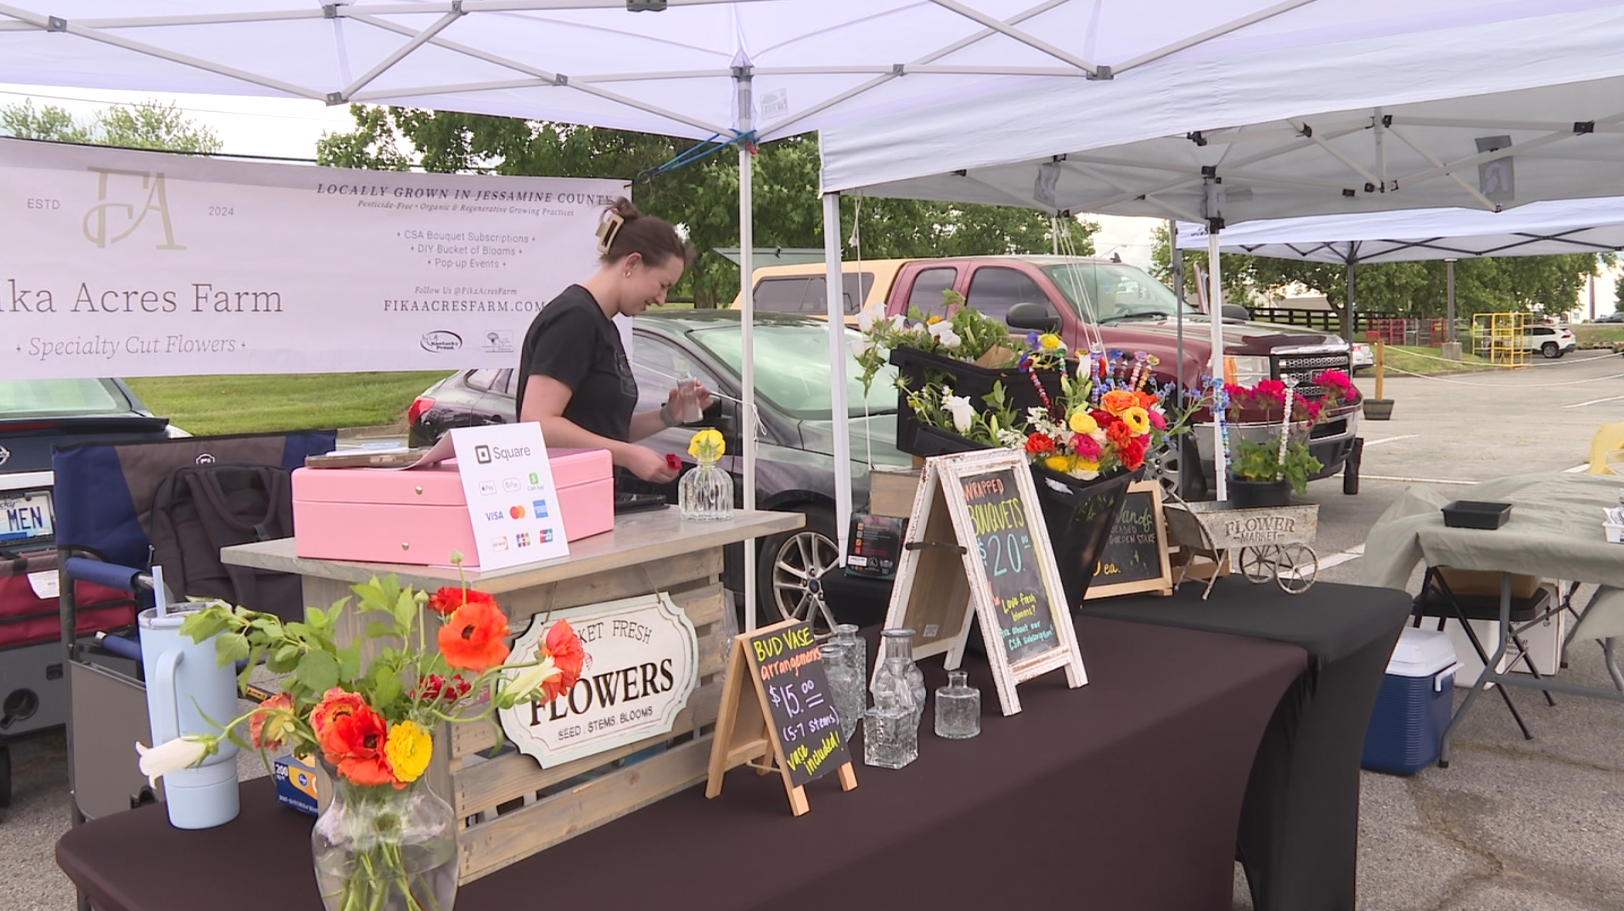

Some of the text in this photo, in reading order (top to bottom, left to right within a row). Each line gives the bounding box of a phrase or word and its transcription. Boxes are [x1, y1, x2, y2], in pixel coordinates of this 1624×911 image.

[317, 183, 388, 197] LOCALLY
[393, 187, 449, 200] GROWN
[454, 189, 471, 200] IN
[475, 190, 553, 202] JESSAMINE
[27, 198, 60, 210] ESTD
[208, 206, 234, 217] 2024
[357, 200, 413, 210] Pesticide-Free
[420, 203, 450, 213] Organic
[460, 204, 507, 214] Regenerative
[508, 206, 540, 217] Growing
[542, 207, 574, 217] Practices
[404, 230, 529, 243] CSA Bouquet Subscriptions
[418, 244, 516, 256] DIY Bucket of Blooms
[435, 258, 499, 269] Pop-up Events
[0, 279, 284, 313] ka Acres Farm
[415, 286, 440, 295] Follow
[384, 300, 546, 312] FIKAACRESFARM.COM
[28, 334, 236, 361] Specialty Cut Flowers
[493, 446, 531, 461] Square
[964, 479, 1004, 501] WRAPPED
[485, 511, 504, 521] VISA
[967, 498, 1025, 537] BOUQUETS
[1224, 516, 1295, 537] FLOWER
[1240, 531, 1278, 543] MARKET
[612, 620, 653, 644] FRESH
[753, 627, 814, 662] BUD VASE
[1008, 637, 1022, 651] CSA
[760, 646, 822, 680] arrangements
[620, 705, 653, 723] BLOOMS
[809, 706, 840, 733] stems)
[275, 764, 288, 777] 200
